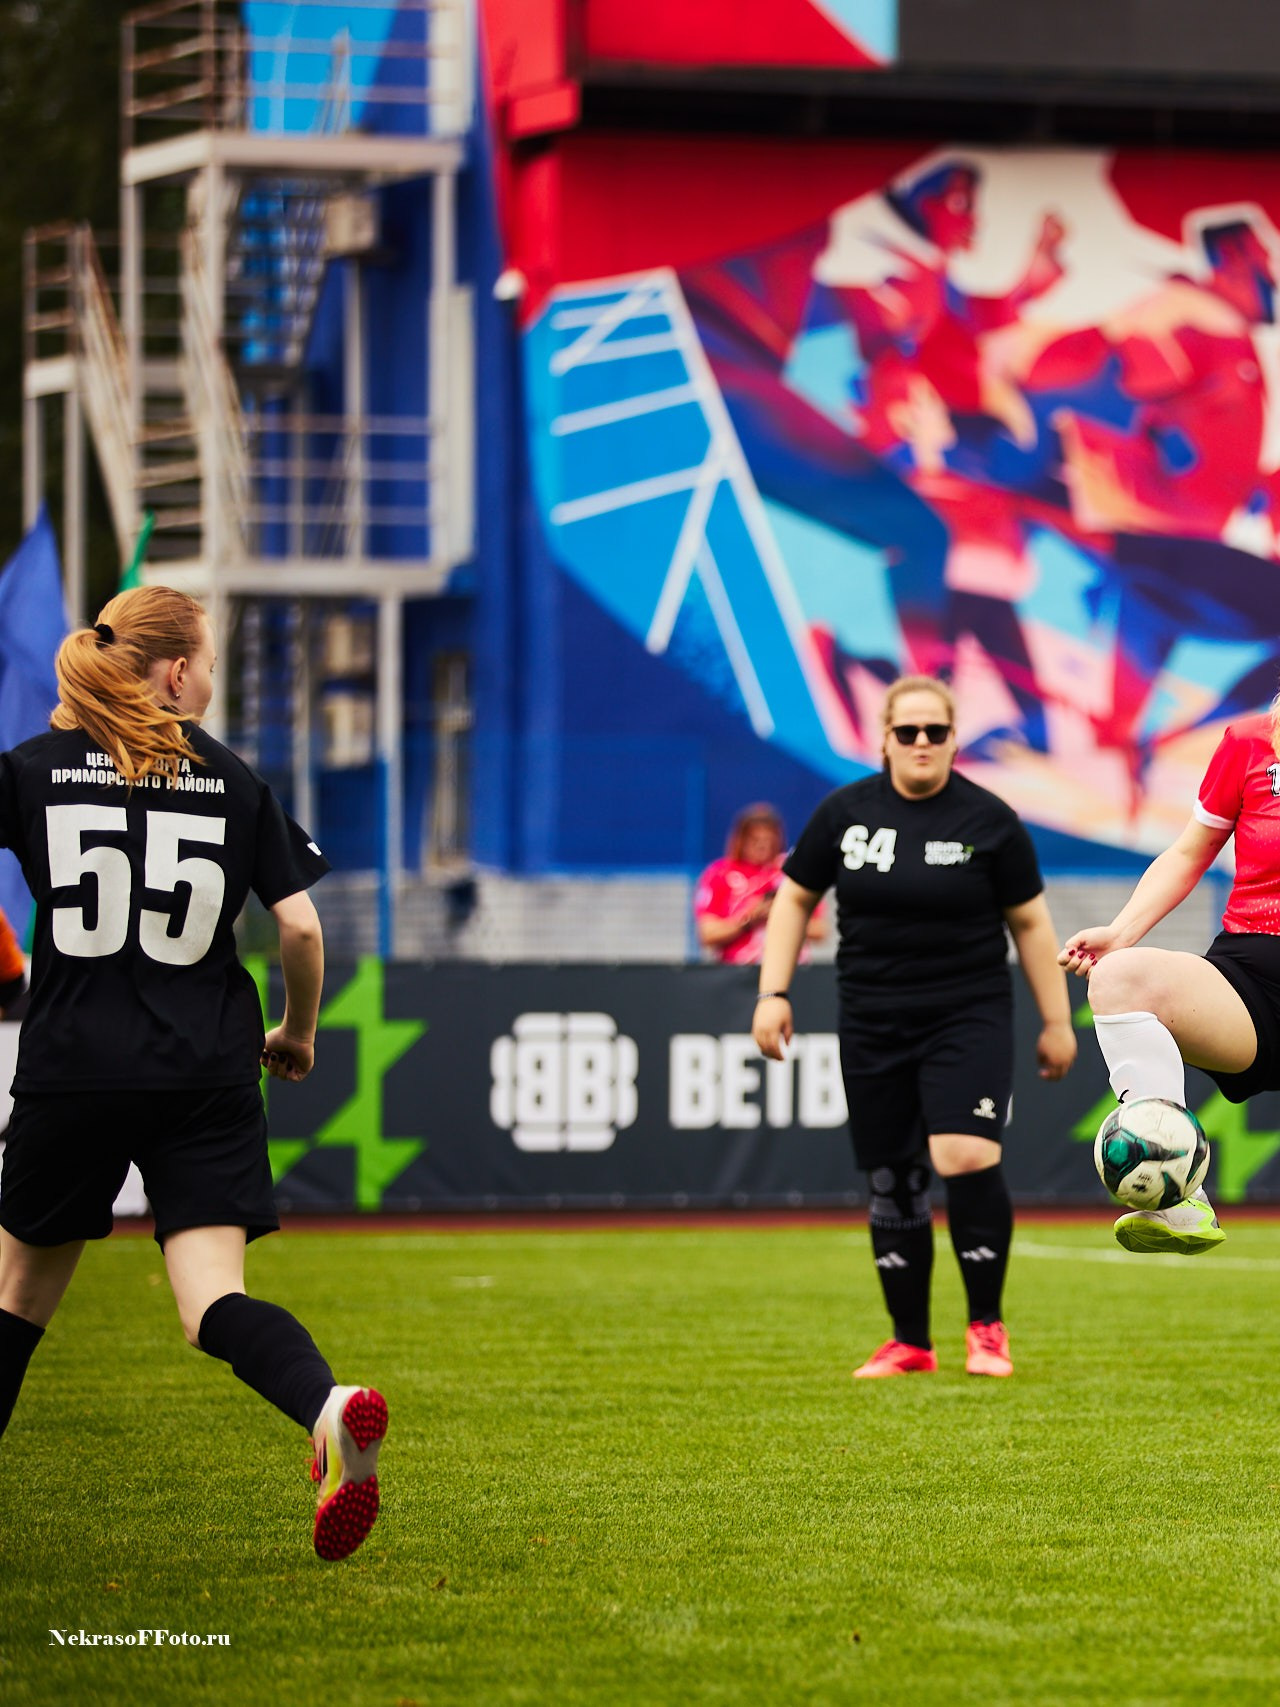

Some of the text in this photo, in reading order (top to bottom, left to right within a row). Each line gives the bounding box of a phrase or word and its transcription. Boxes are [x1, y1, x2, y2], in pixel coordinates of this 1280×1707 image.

[86, 752, 114, 768] ЦЕН
[166, 772, 225, 794] РАЙОНА
[46, 804, 226, 966] 55
[669, 1033, 850, 1129] BETB
